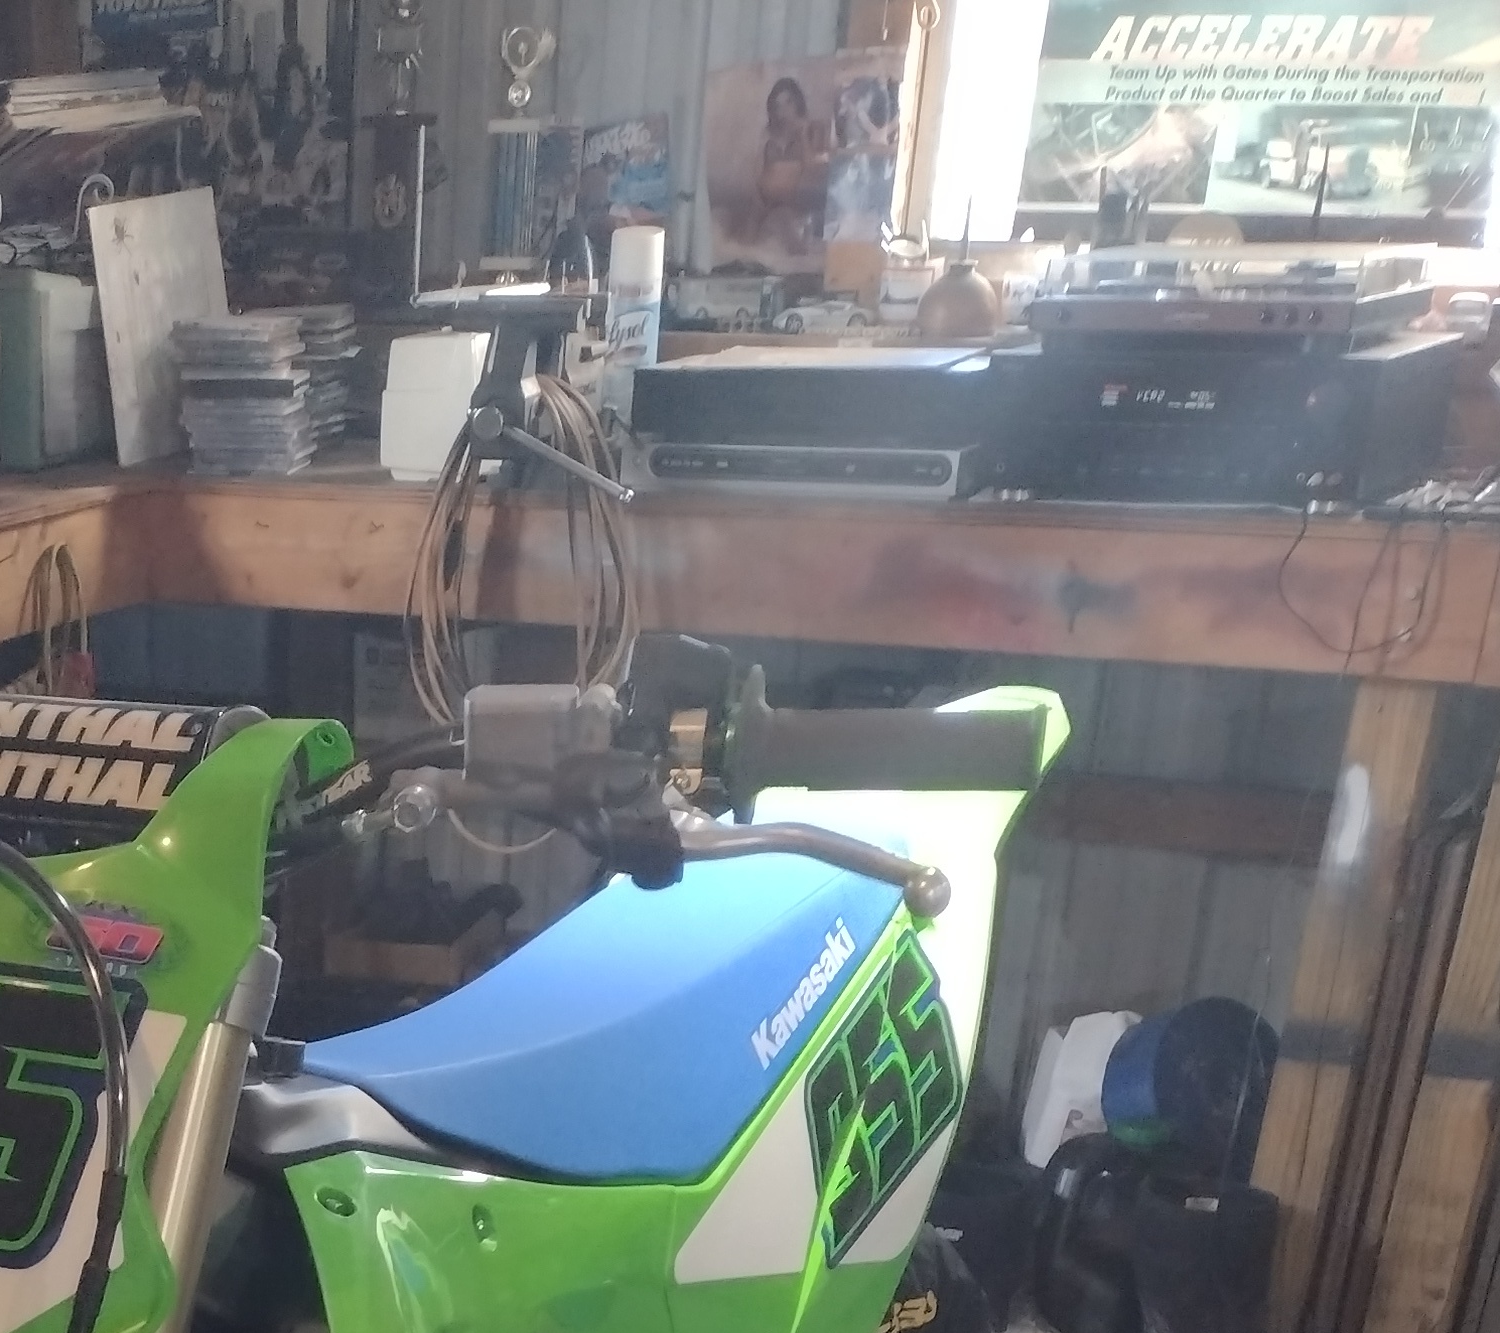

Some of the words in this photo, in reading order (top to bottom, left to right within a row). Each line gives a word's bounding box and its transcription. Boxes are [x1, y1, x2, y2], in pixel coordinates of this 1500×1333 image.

[1089, 14, 1435, 63] ACCELERATE
[1109, 64, 1151, 81] Team
[1155, 64, 1178, 86] Up
[1182, 63, 1218, 81] with
[1223, 64, 1269, 82] Gates
[1273, 64, 1329, 85] During
[1334, 64, 1360, 82] the
[1364, 64, 1485, 86] Transportation
[1105, 86, 1165, 101] Product
[1169, 84, 1189, 101] of
[1190, 85, 1216, 101] the
[1220, 86, 1286, 102] Quarter
[1289, 87, 1306, 102] to
[1311, 87, 1358, 102] Boost
[1361, 87, 1405, 103] Sales
[1409, 86, 1444, 103] and
[607, 312, 649, 348] Lysol
[750, 916, 857, 1071] Kawasaki
